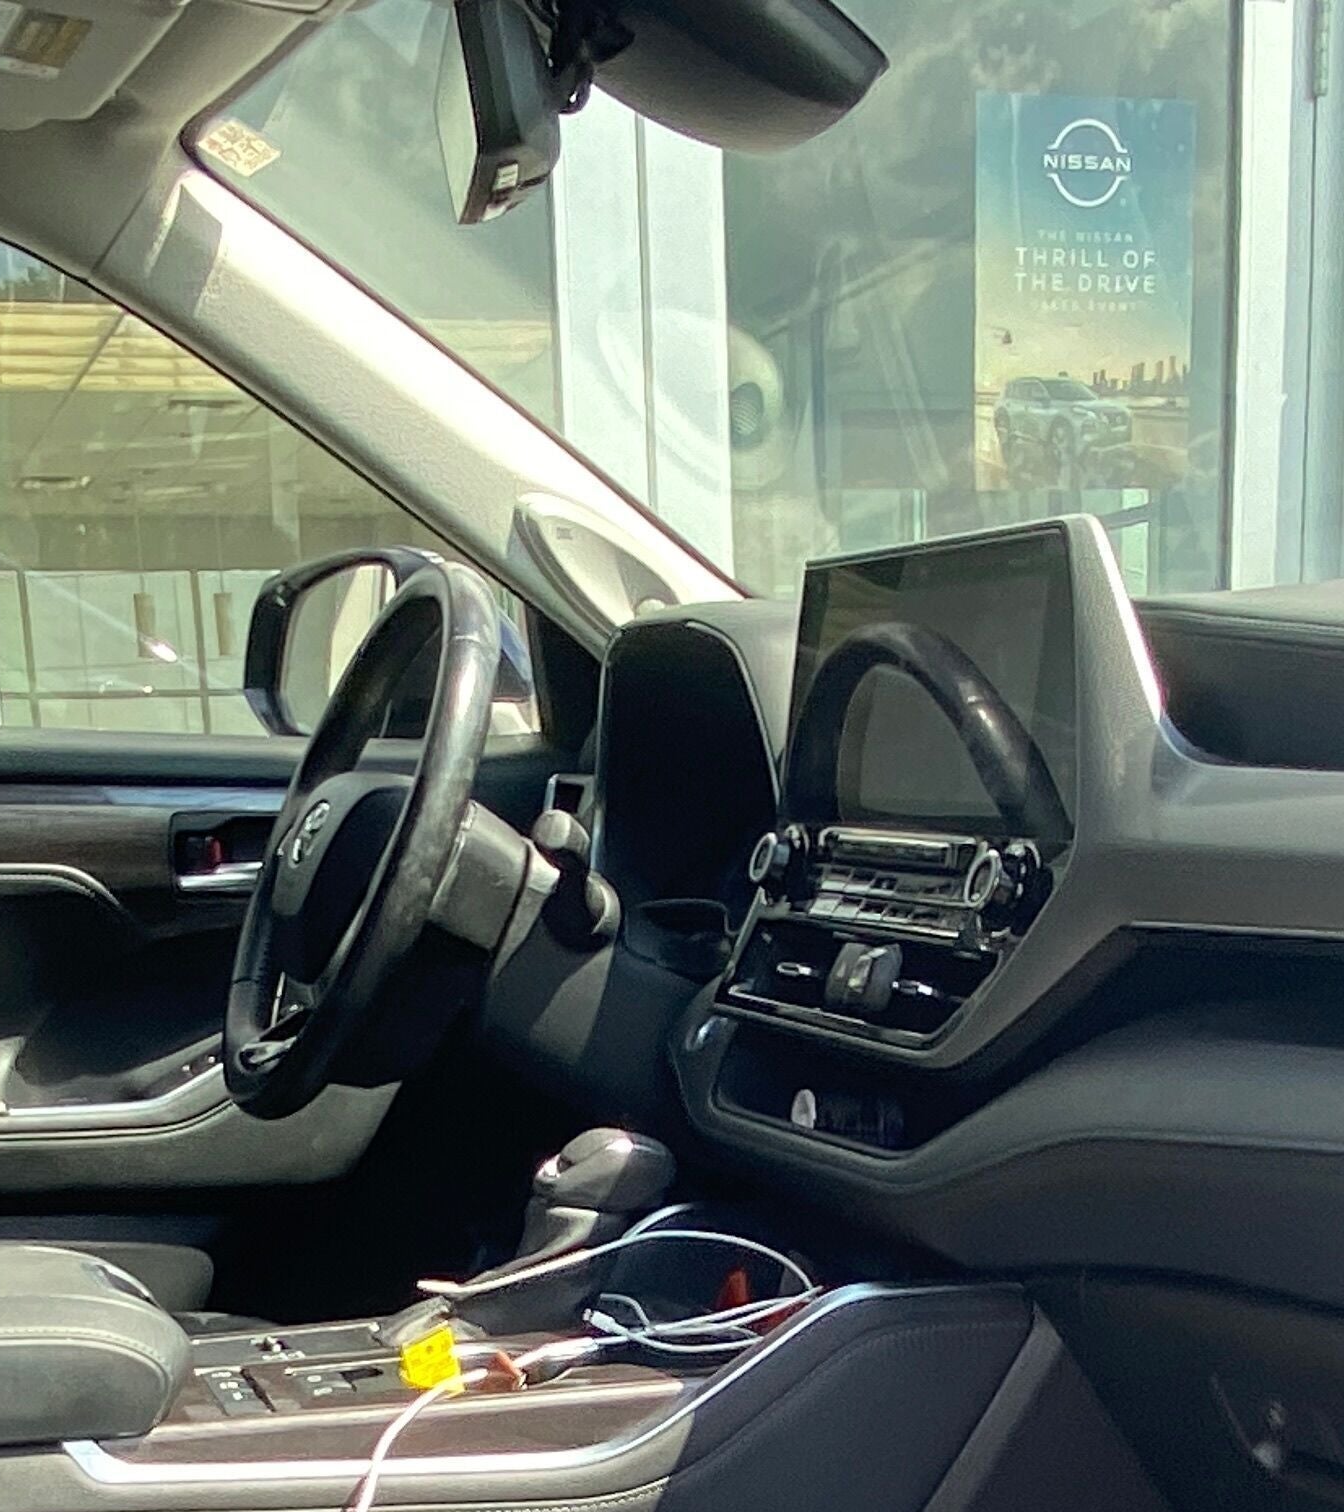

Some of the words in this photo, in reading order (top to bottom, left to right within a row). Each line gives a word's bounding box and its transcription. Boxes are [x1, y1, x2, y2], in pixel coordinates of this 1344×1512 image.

[1043, 153, 1132, 172] NISSAN
[1014, 246, 1109, 269] THRILL
[1122, 248, 1157, 270] OF
[1013, 272, 1065, 293] THE
[1078, 273, 1157, 295] DRIVE
